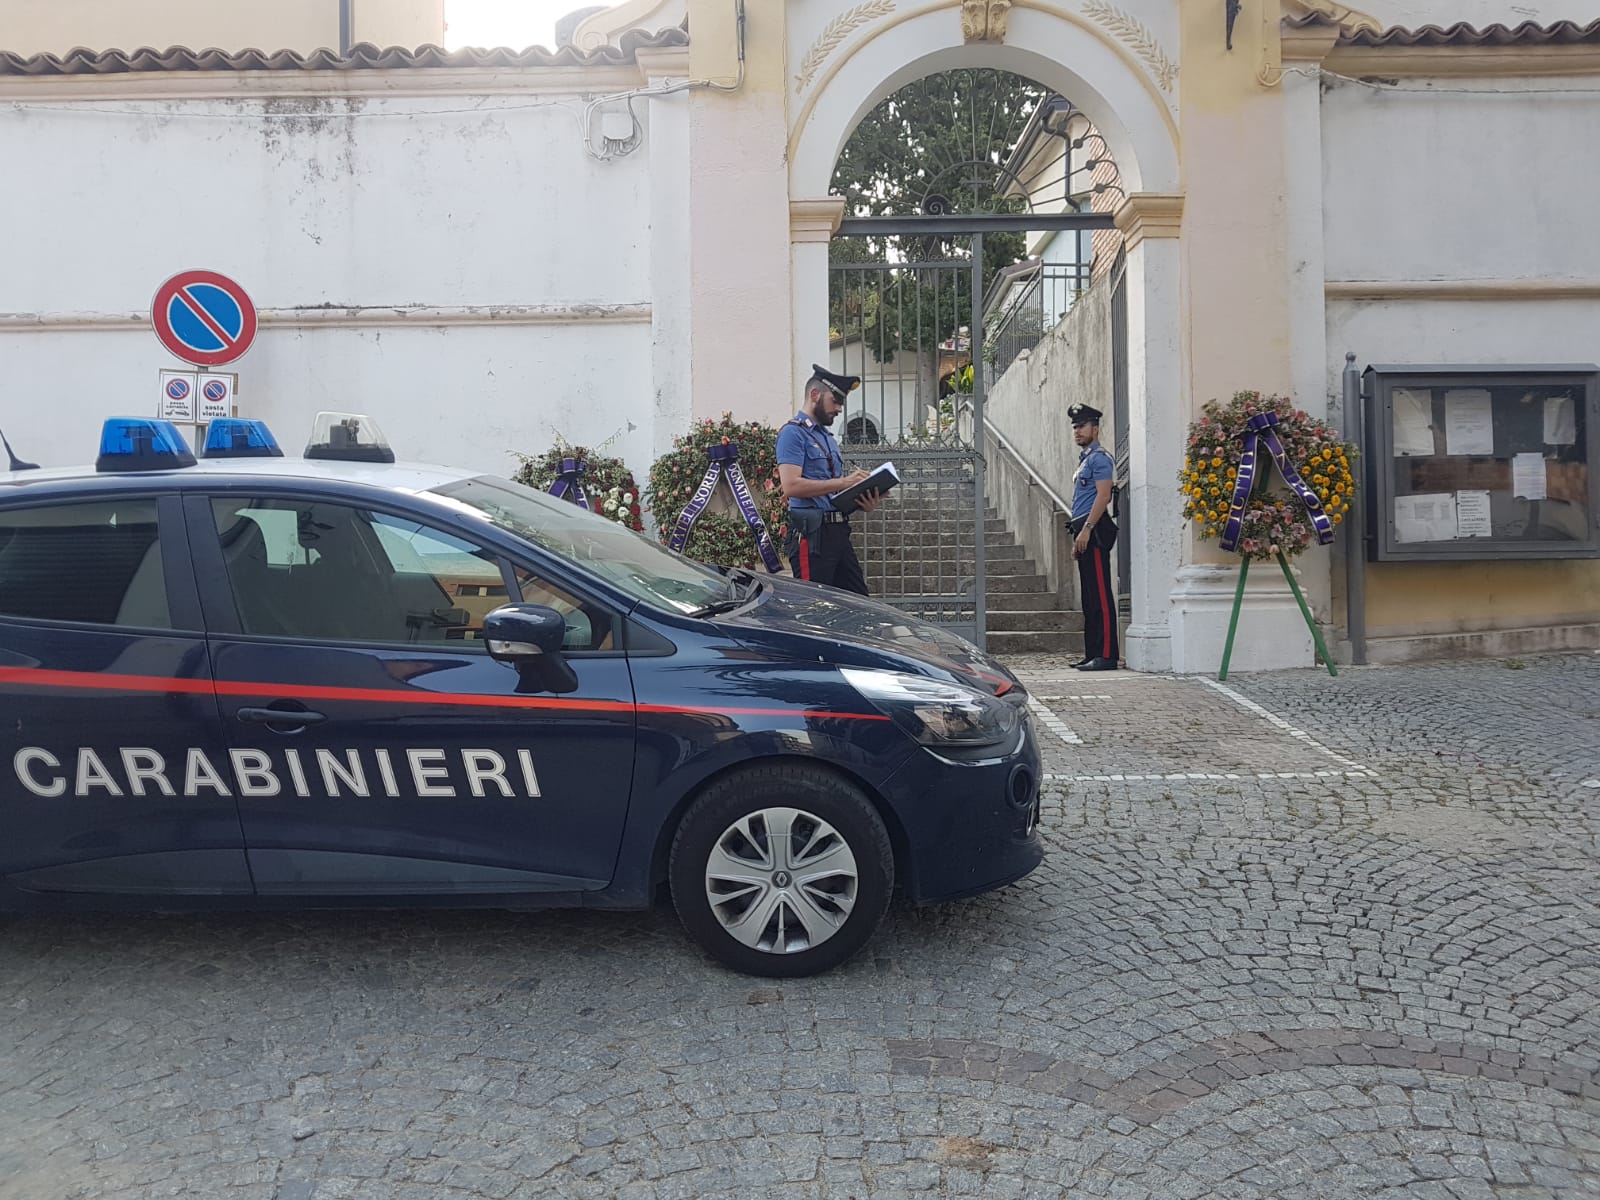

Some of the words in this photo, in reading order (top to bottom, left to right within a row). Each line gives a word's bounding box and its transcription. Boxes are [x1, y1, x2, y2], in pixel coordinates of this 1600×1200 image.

[728, 462, 749, 499] OGNATI
[671, 503, 702, 552] RATELLI
[13, 747, 542, 798] CARABINIERI
